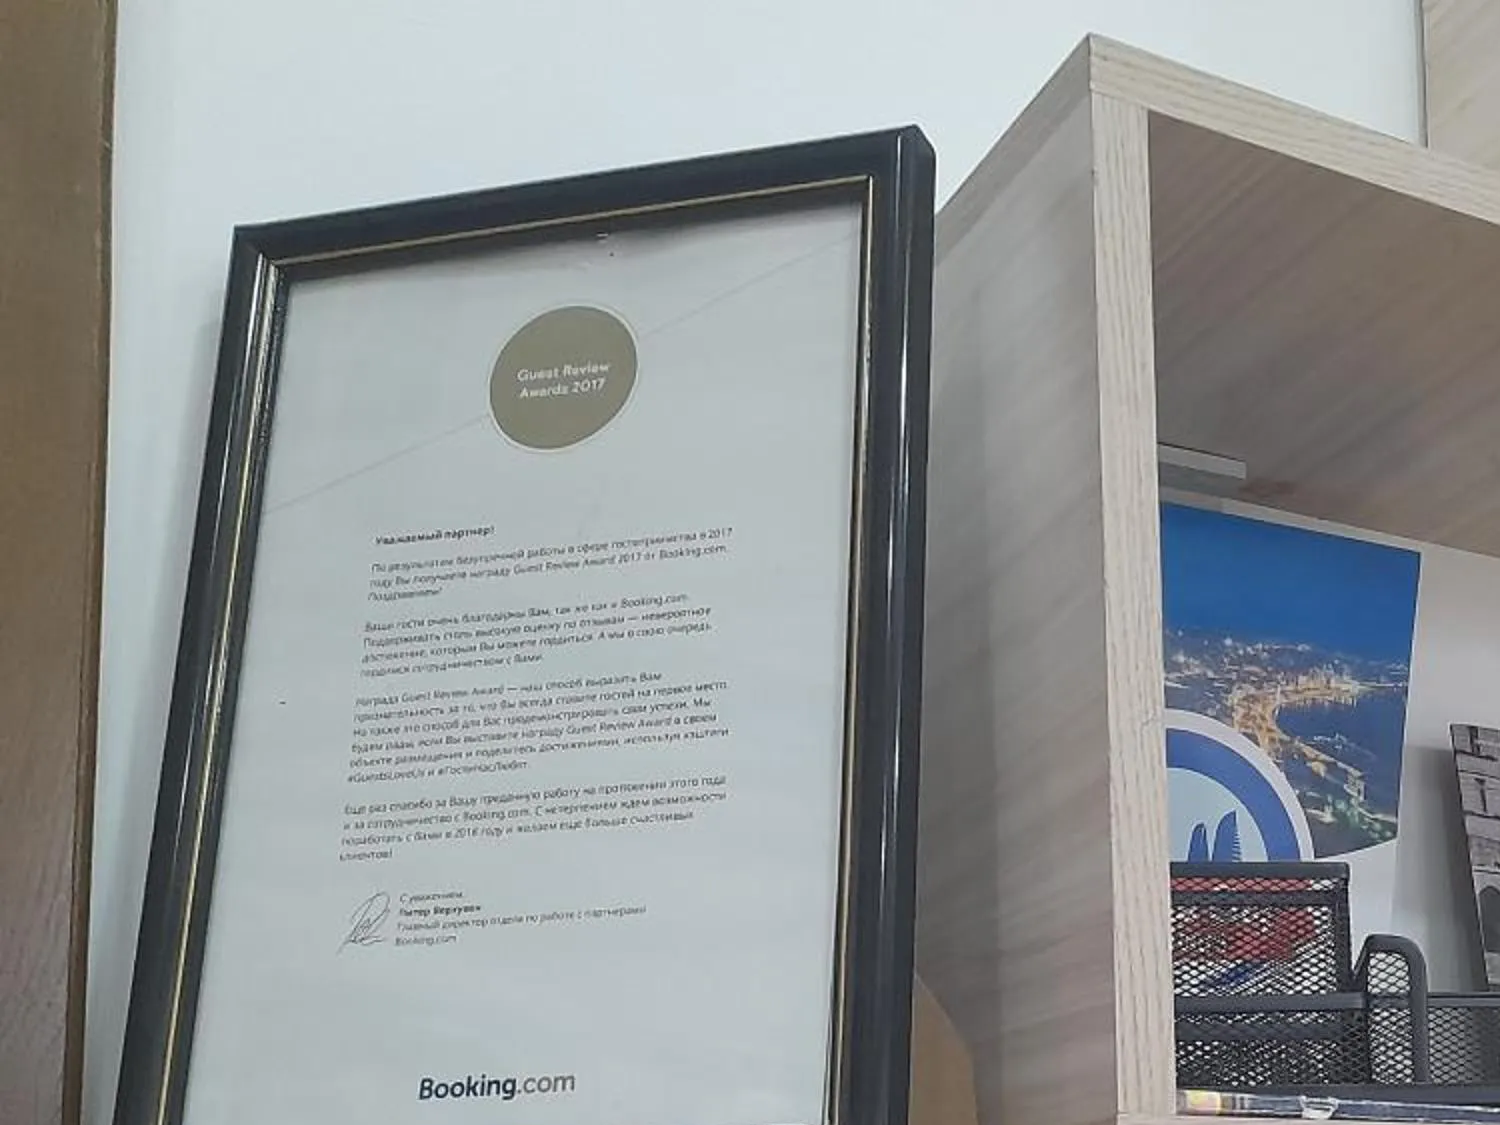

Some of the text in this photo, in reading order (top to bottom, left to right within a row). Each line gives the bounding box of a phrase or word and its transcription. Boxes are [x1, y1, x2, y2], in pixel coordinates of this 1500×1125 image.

[517, 361, 610, 382] Guest Review
[519, 378, 606, 398] Awards 2017
[418, 1072, 576, 1101] Booking.com
